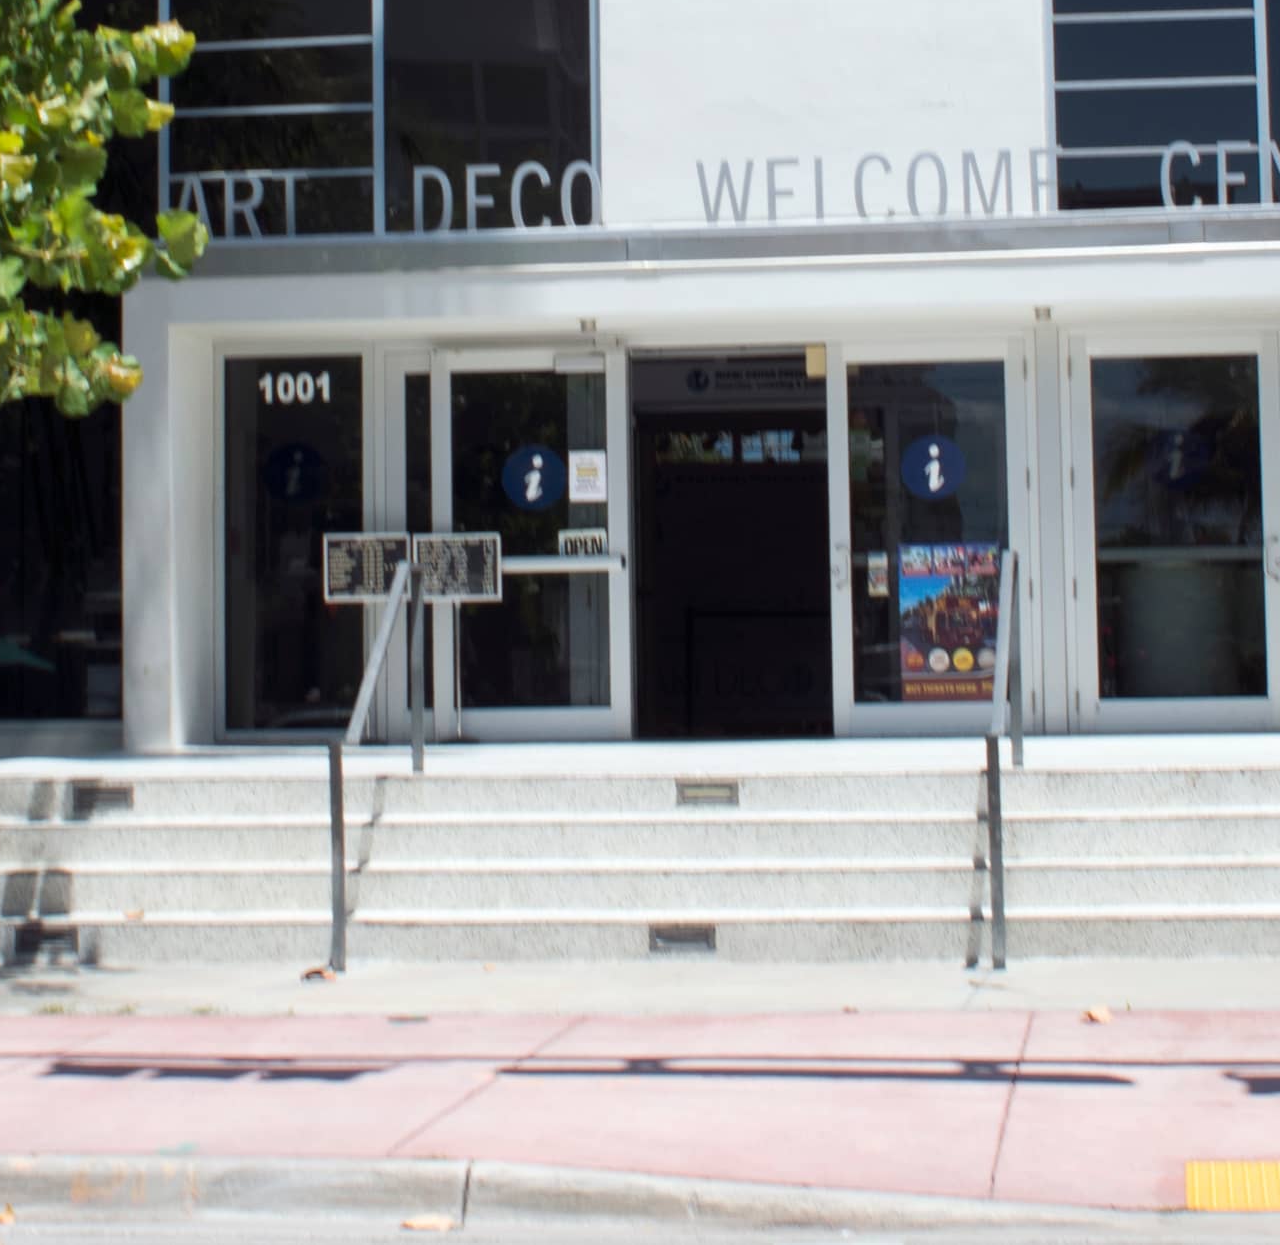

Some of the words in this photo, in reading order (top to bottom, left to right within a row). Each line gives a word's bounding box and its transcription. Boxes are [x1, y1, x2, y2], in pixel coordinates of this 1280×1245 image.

[177, 168, 308, 239] ART
[413, 160, 602, 234] DECO
[258, 370, 332, 405] 1001
[564, 535, 604, 555] OPEN
